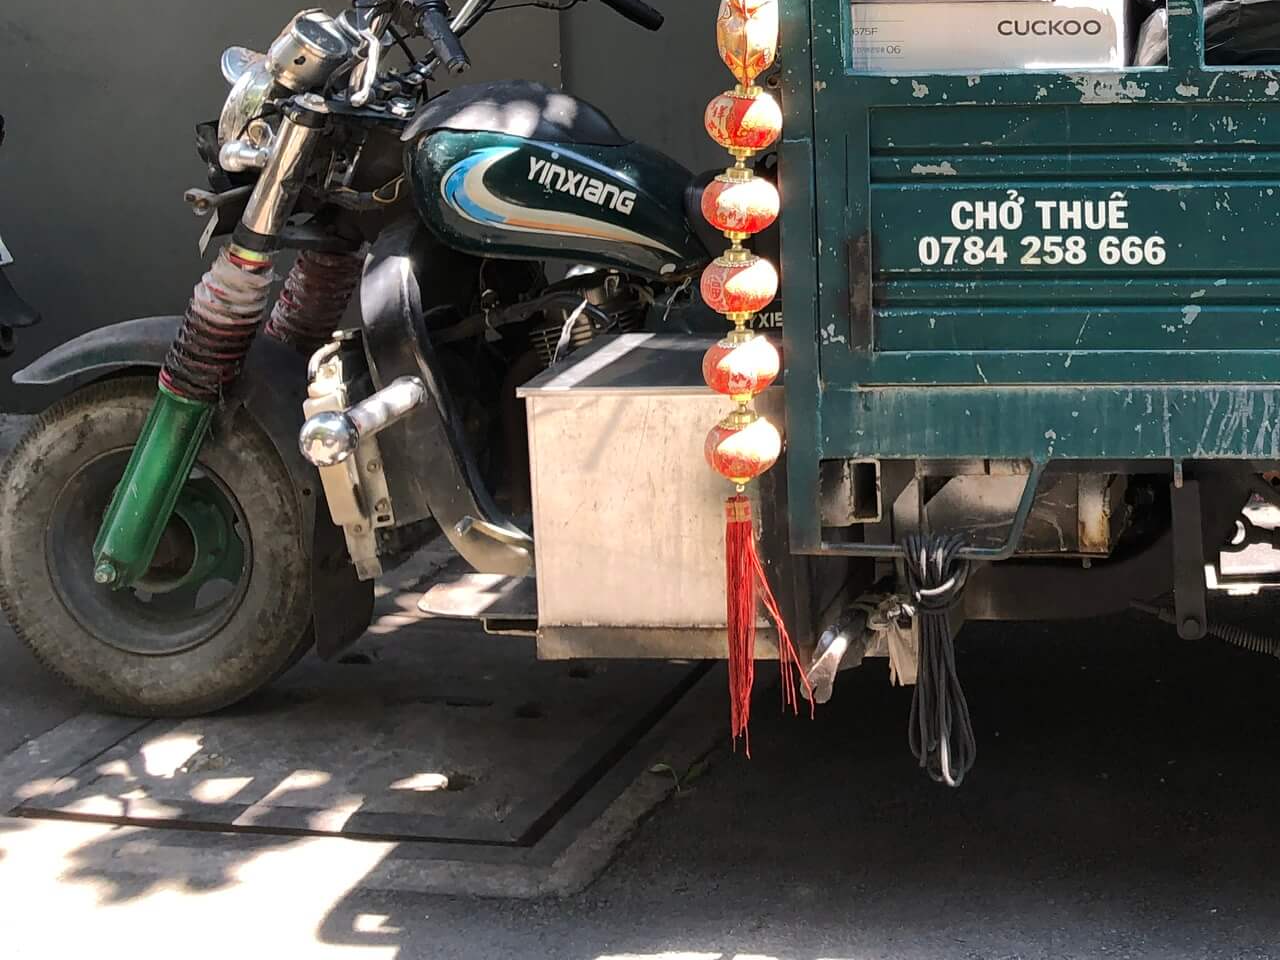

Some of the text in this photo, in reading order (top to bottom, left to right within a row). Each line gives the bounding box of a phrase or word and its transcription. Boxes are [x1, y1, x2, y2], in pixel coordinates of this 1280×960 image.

[997, 19, 1102, 36] CUCKOO
[526, 155, 637, 215] YINXIANG
[950, 189, 1129, 230] CHỞ THUÊ
[918, 235, 1167, 266] 0784 258 666
